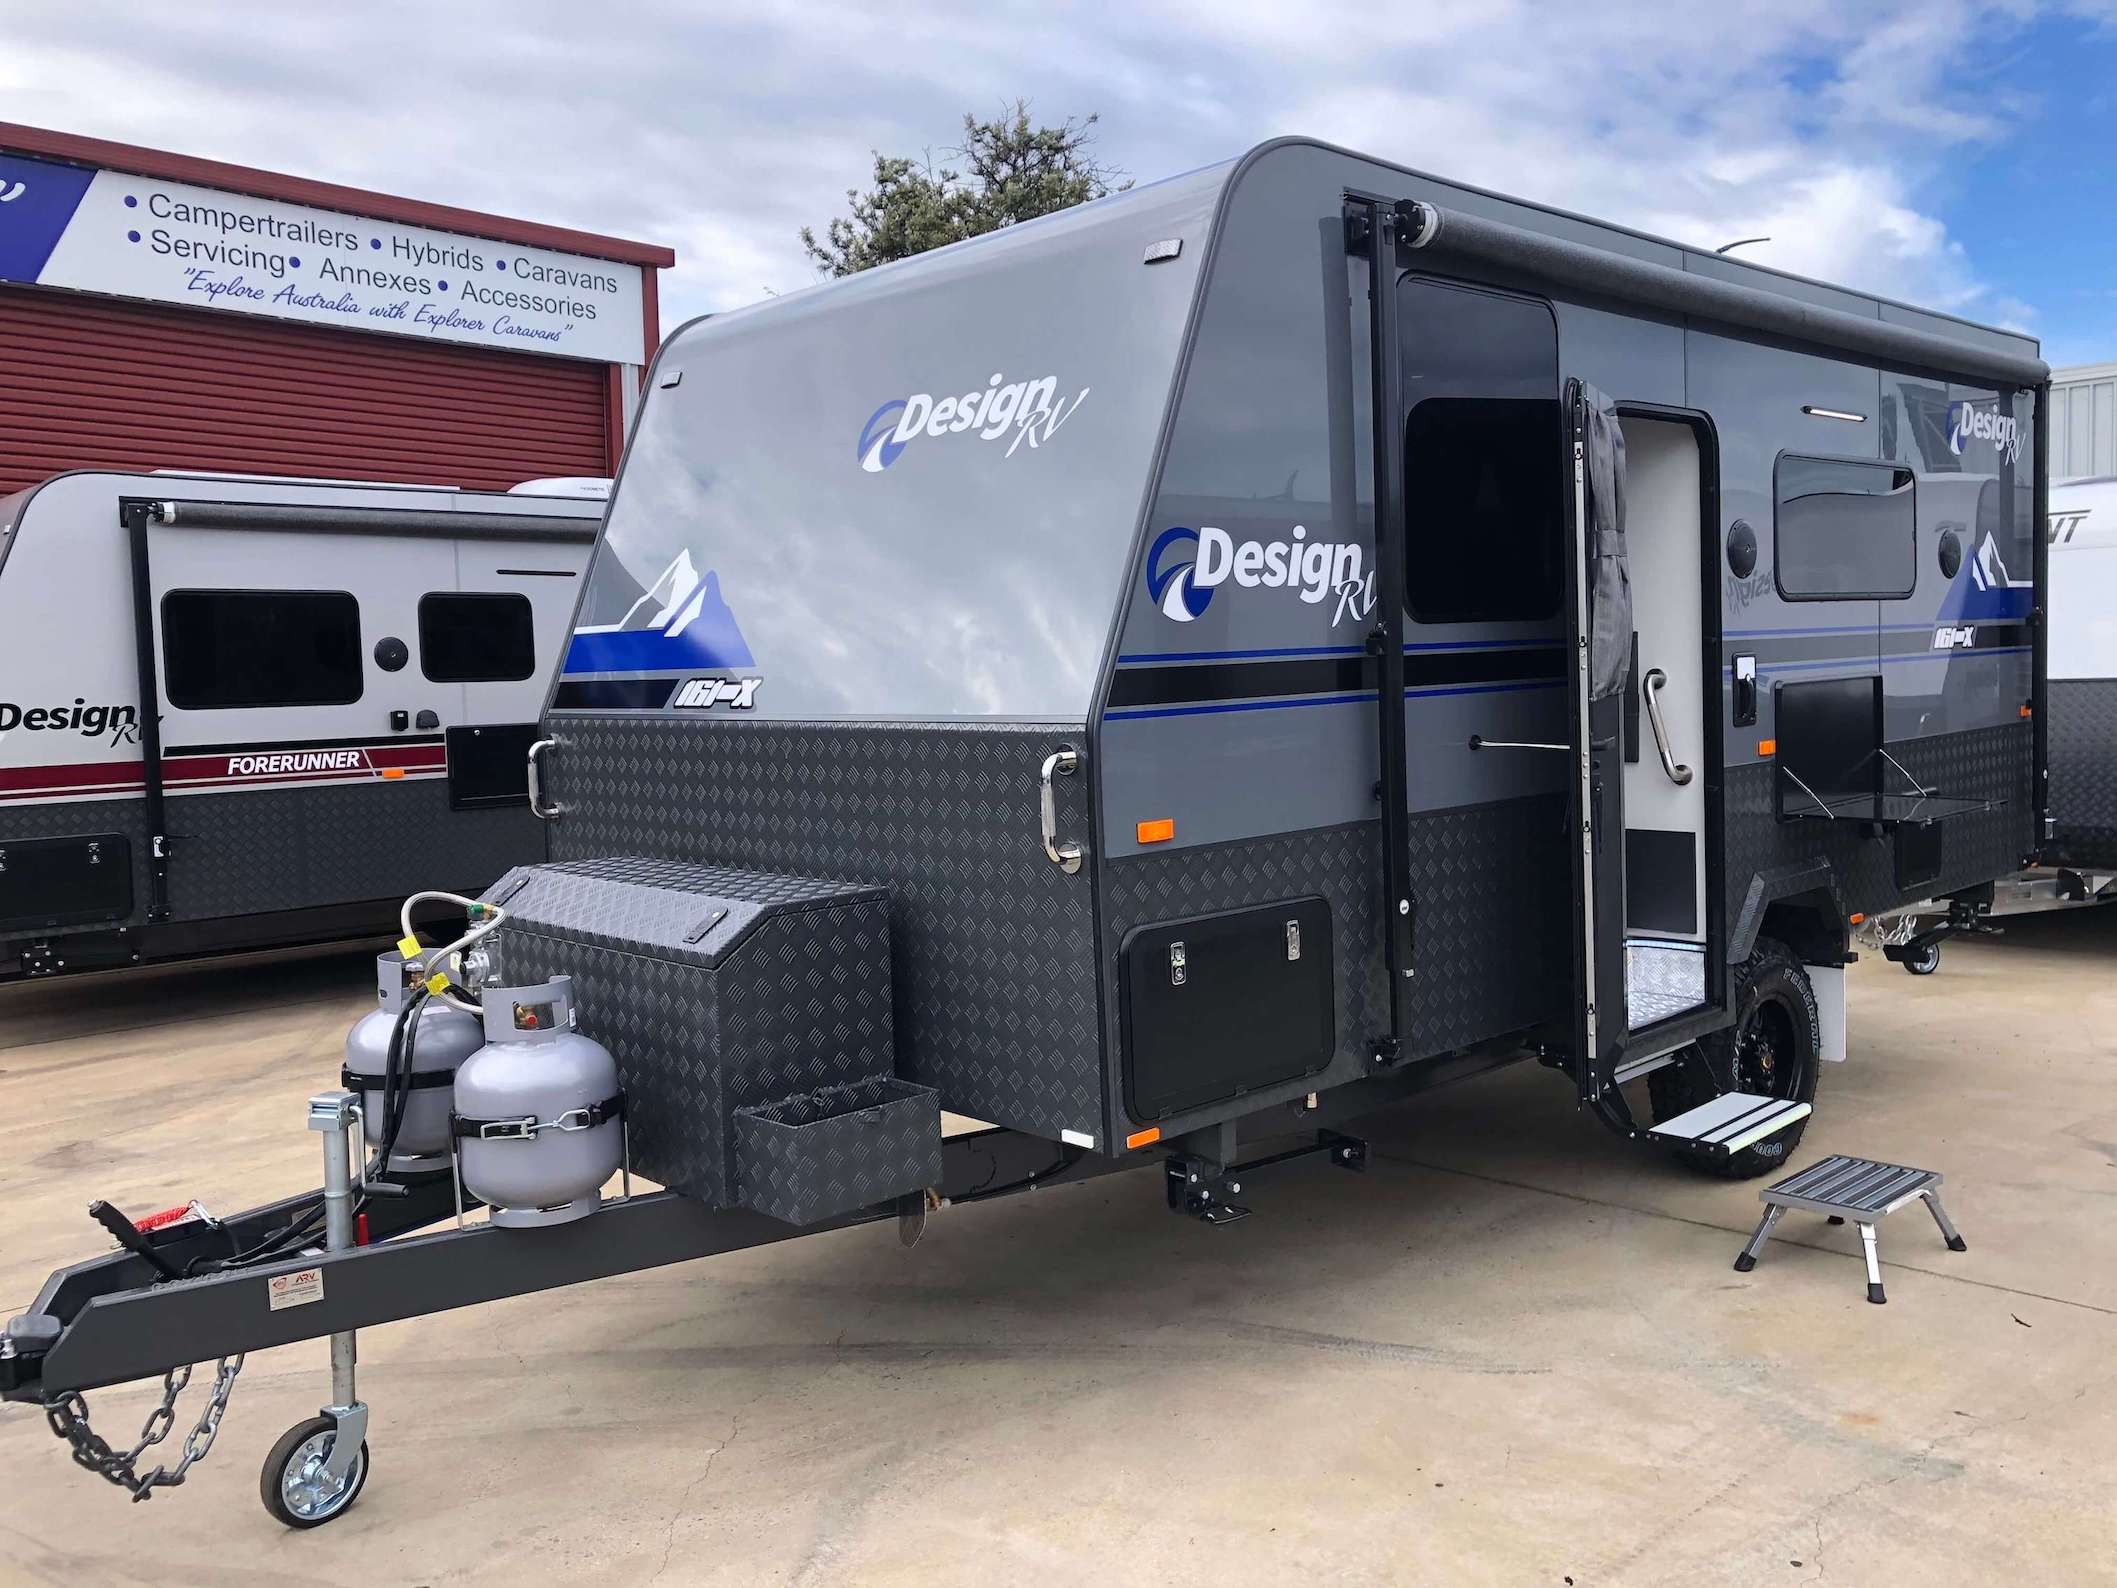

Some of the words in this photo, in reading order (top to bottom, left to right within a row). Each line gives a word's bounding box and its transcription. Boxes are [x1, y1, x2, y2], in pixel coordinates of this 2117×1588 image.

[149, 193, 359, 251] Campertrailers
[392, 236, 484, 272] Hybrids
[513, 257, 618, 293] Caravans
[151, 229, 286, 278] Servicing
[319, 257, 432, 295] Annexes
[460, 280, 597, 320] Accessories
[271, 283, 362, 314] Australia
[368, 301, 411, 320] with
[413, 303, 486, 333] Explorer
[892, 372, 1058, 443] Design
[1004, 386, 1091, 459] RV
[1960, 401, 2017, 452] Design
[2004, 432, 2027, 467] RV
[1193, 525, 1363, 604] Design
[0, 698, 136, 737] Design
[227, 751, 360, 775] FORERUNNER
